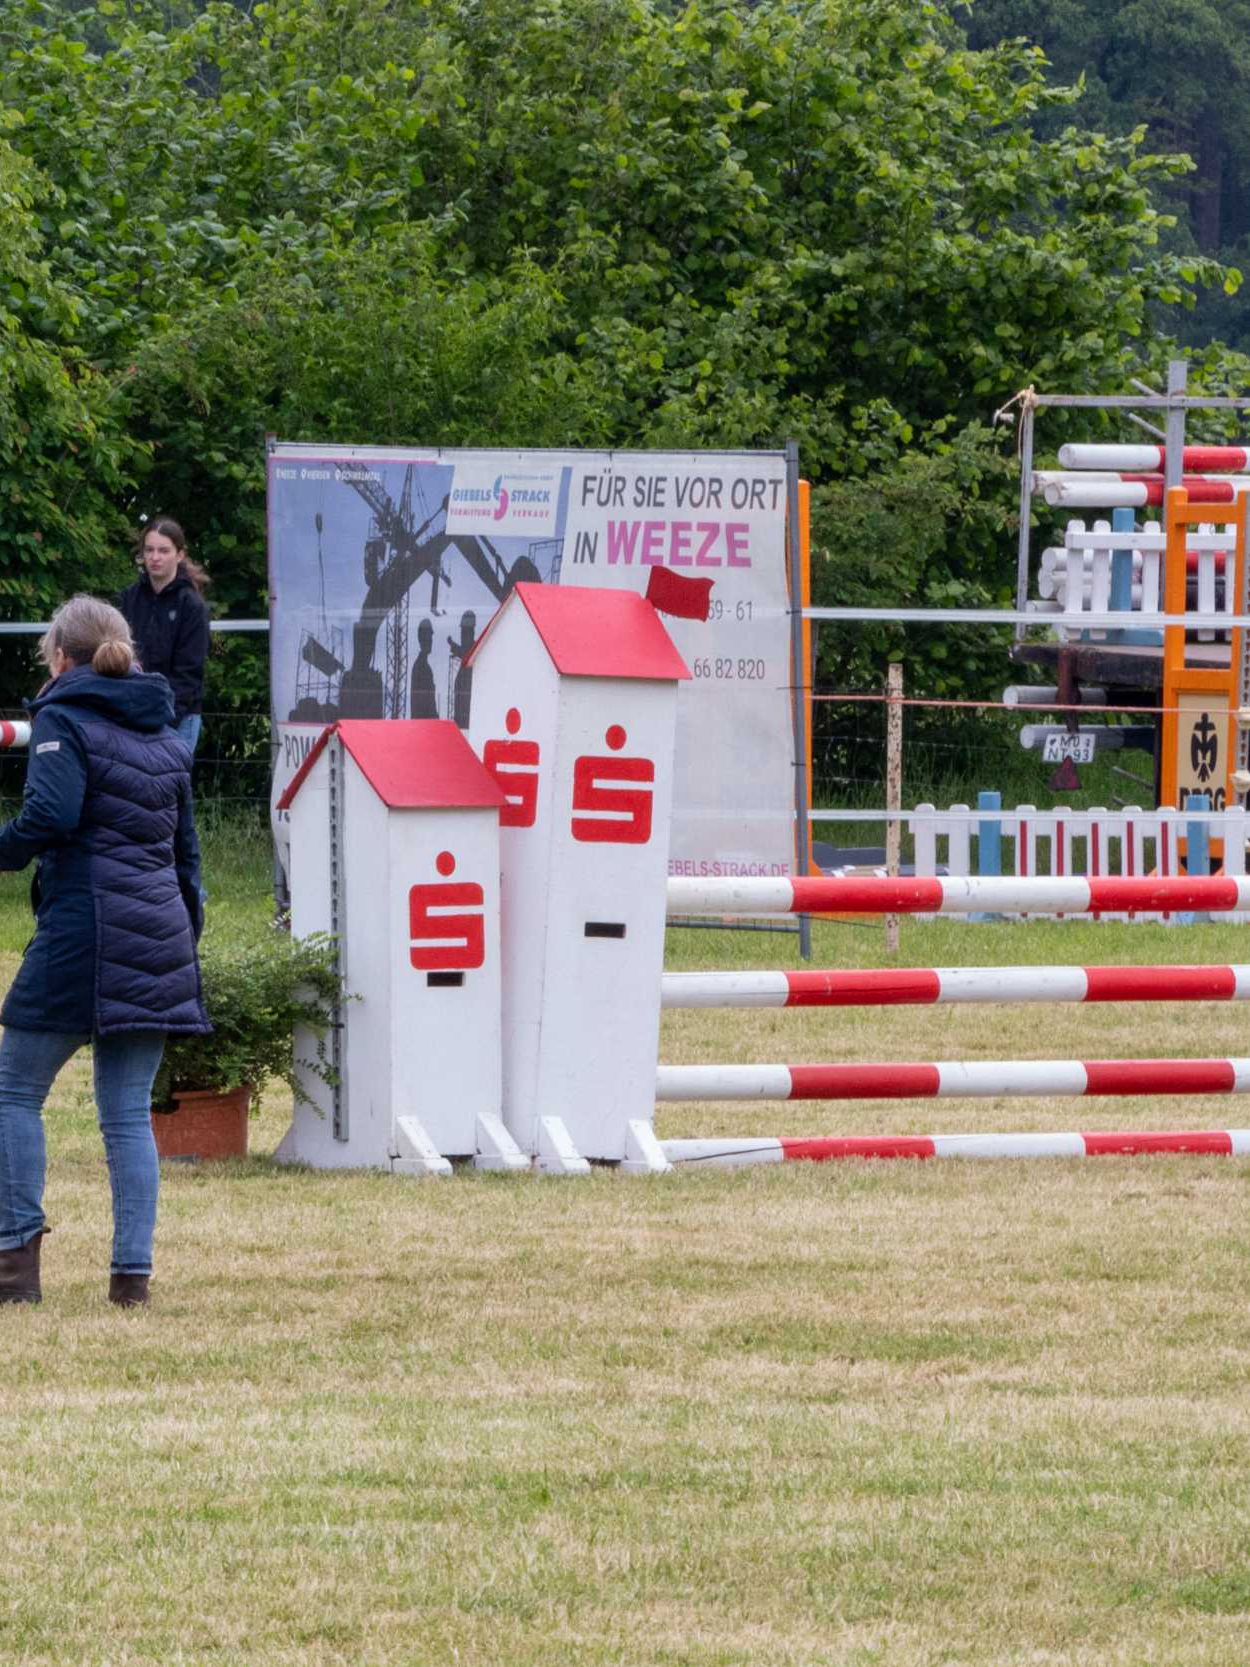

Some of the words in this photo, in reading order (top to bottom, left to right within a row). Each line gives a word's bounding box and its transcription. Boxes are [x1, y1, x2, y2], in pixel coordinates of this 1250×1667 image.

[510, 489, 550, 503] STRACK
[581, 467, 627, 507] FÜR
[633, 476, 667, 508] SIE
[674, 476, 723, 509] VOR
[731, 477, 784, 510] ORT
[573, 531, 598, 564] IN
[607, 520, 752, 567] WEEZE
[736, 600, 753, 621] 61
[694, 658, 711, 679] 66
[715, 658, 733, 679] 82
[738, 658, 765, 680] 820
